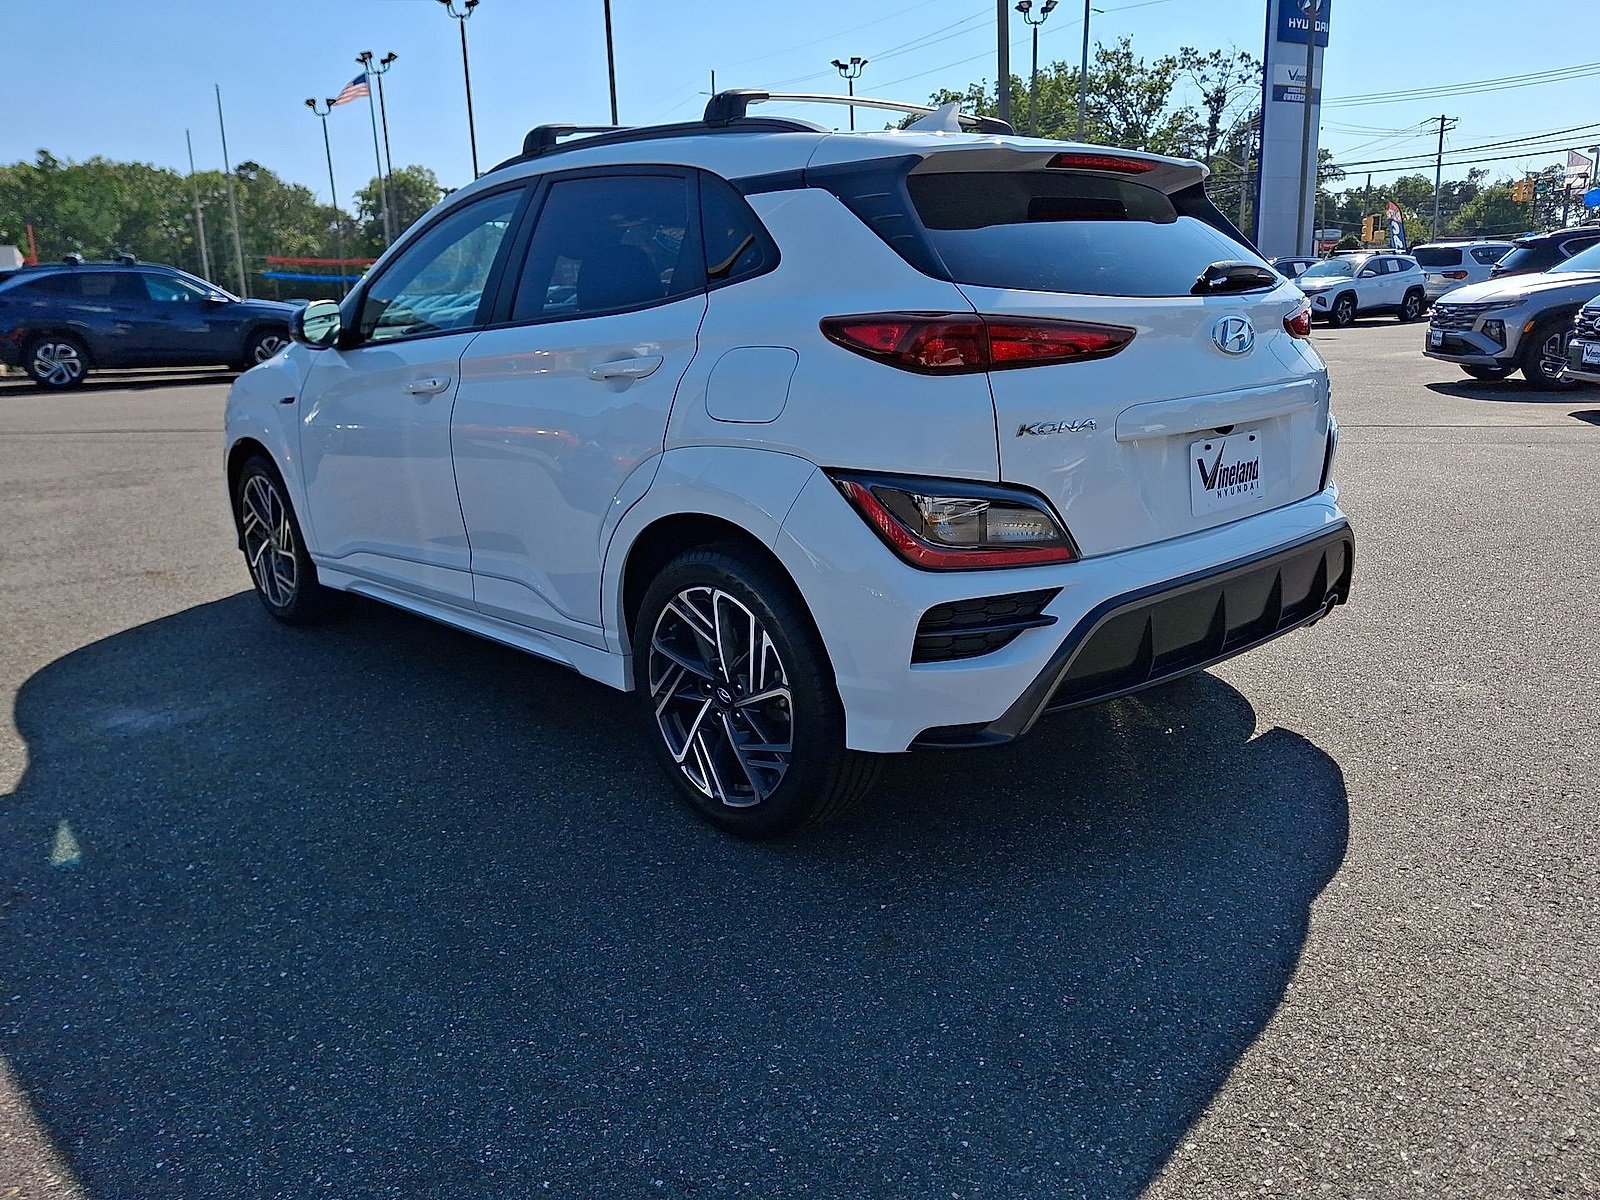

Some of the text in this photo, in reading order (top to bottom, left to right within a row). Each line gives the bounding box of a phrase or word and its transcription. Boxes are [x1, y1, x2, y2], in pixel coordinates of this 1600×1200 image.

[1288, 17, 1329, 33] HYUDAI
[1015, 417, 1097, 438] KONA
[1197, 439, 1259, 491] Vineland
[1216, 480, 1260, 499] HYUNDAI
